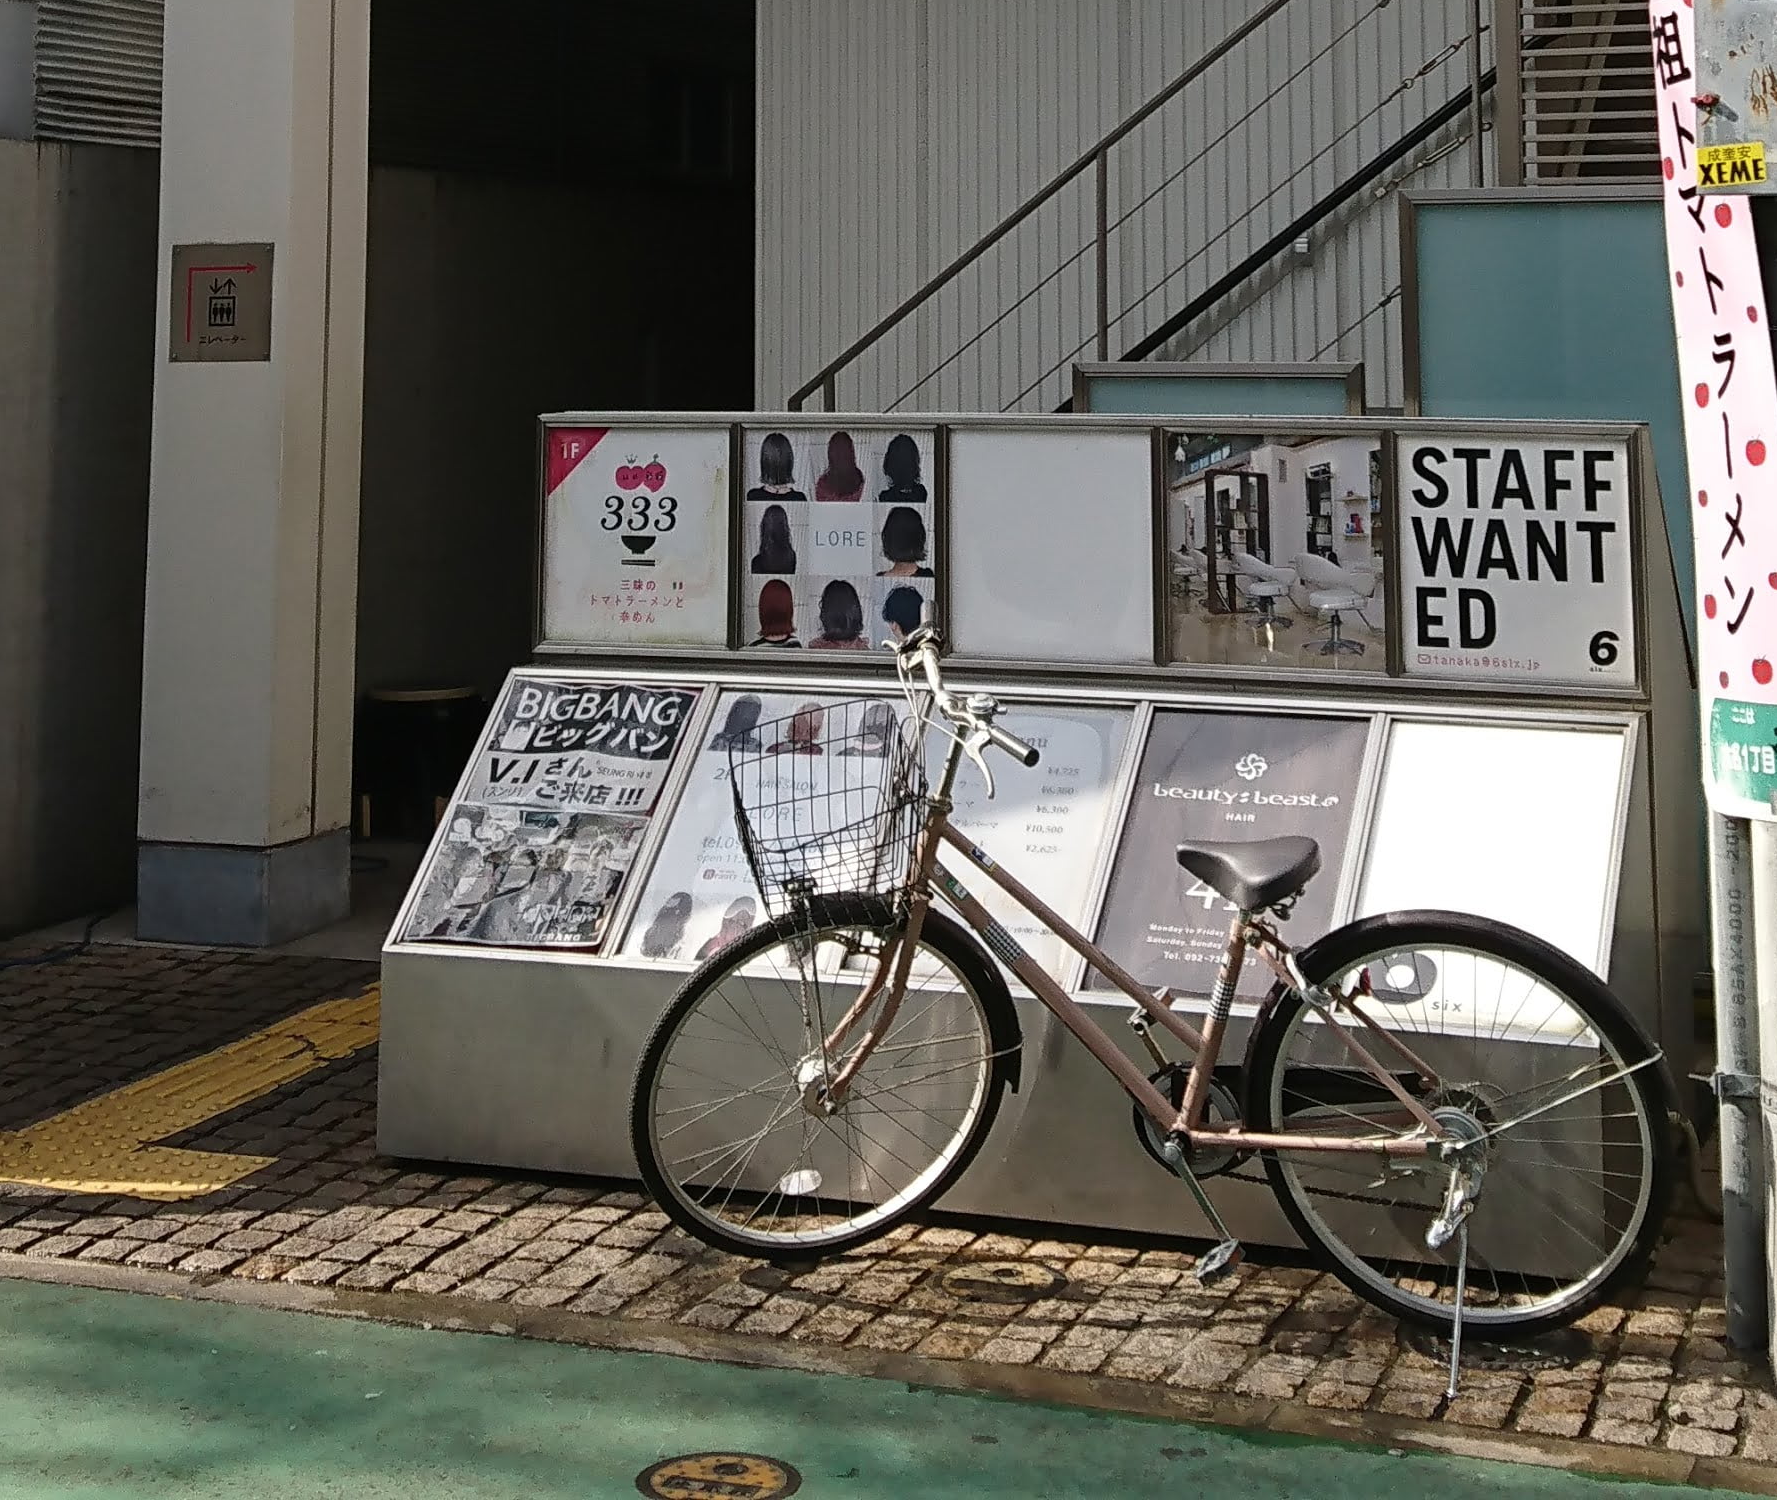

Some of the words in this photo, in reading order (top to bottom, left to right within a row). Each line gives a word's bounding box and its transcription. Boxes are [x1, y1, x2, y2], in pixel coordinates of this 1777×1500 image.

[1698, 158, 1766, 186] XEME
[558, 441, 580, 461] 1F
[1411, 445, 1616, 513] STAFF
[600, 495, 679, 533] 333
[814, 530, 867, 548] LORE
[1412, 515, 1617, 585] WANT
[590, 594, 684, 608] トマトラーメンと
[1415, 585, 1498, 650] ED
[1588, 630, 1620, 667] 6
[515, 687, 683, 726] BIGBANG
[532, 722, 669, 753] ビッグバン
[488, 757, 541, 784] V.I
[543, 756, 593, 780] さん
[535, 779, 612, 805] ご来店
[1225, 812, 1257, 823] HAIR
[1149, 922, 1183, 935] Monday
[1184, 926, 1195, 935] to
[1195, 928, 1225, 938] Friday
[1190, 939, 1223, 950] Sunday
[1431, 1001, 1462, 1013] six
